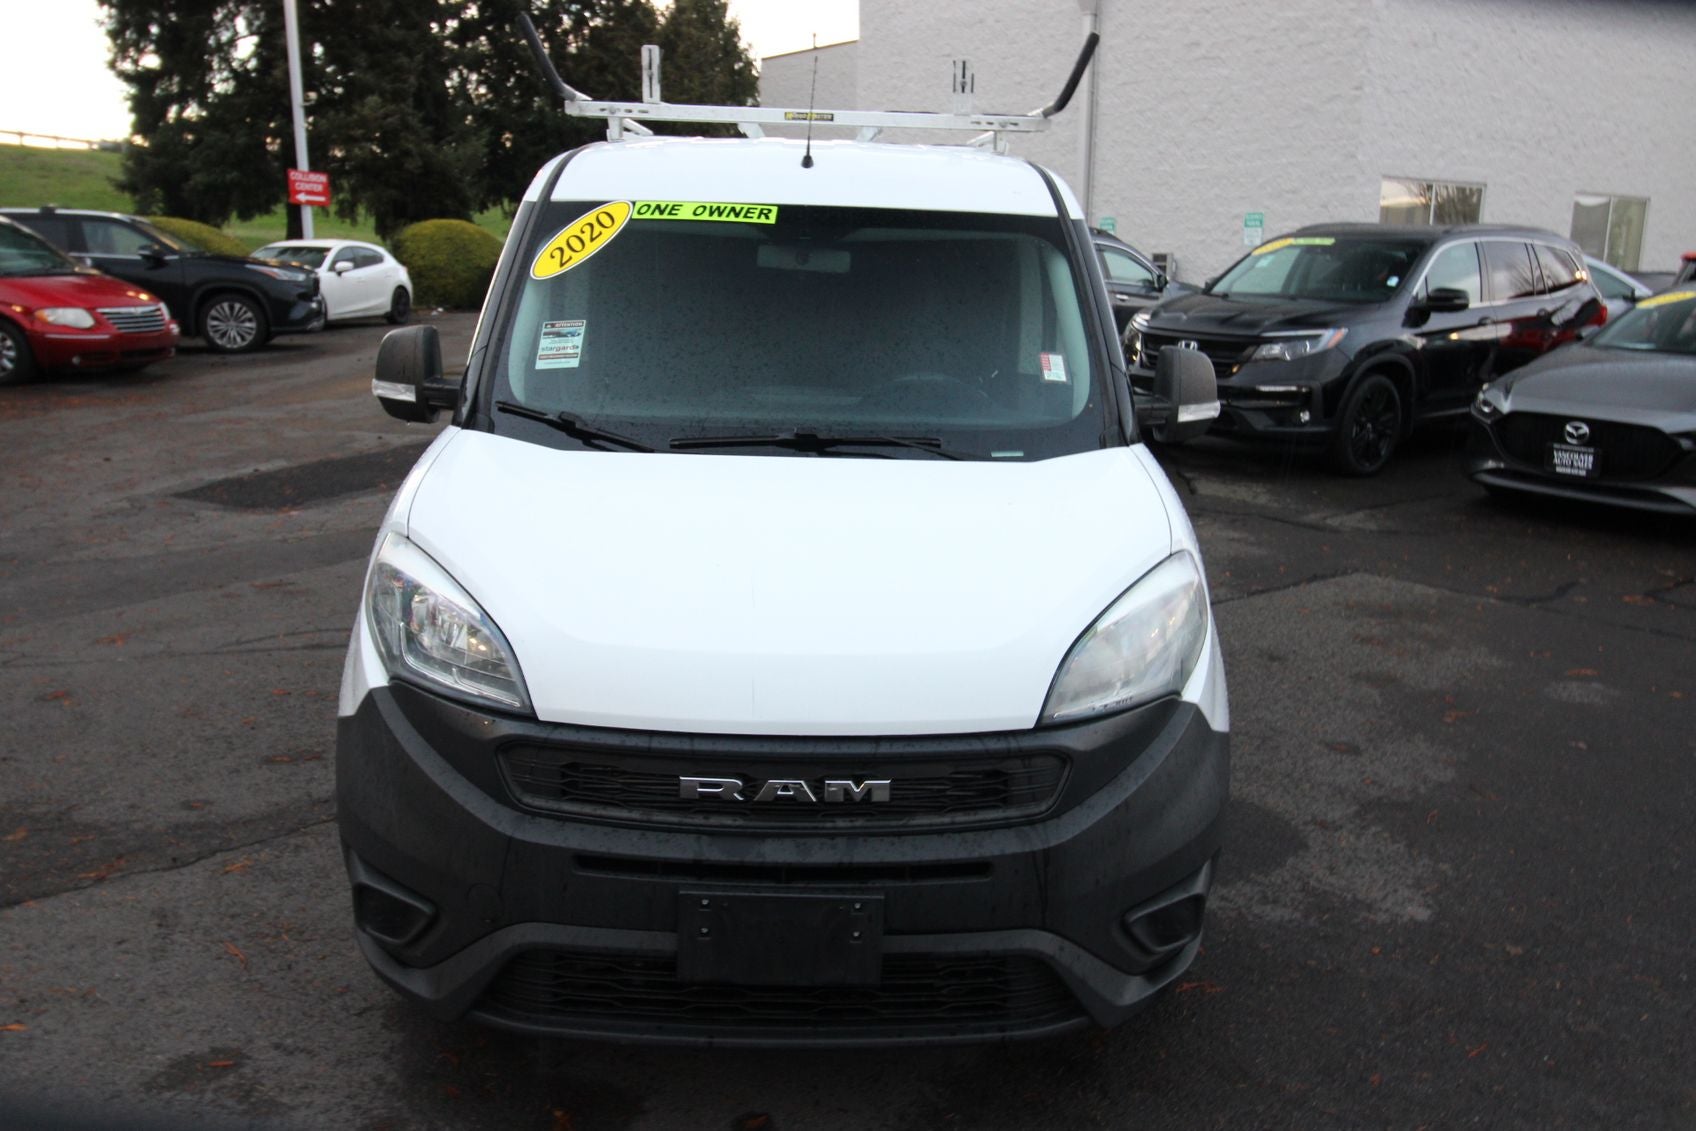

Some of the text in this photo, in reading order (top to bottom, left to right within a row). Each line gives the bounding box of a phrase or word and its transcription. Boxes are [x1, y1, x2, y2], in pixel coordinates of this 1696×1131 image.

[290, 171, 328, 183] COLLISION
[295, 182, 323, 192] CENTER
[636, 203, 773, 221] ONE OWNER
[550, 211, 616, 268] 2020
[679, 776, 891, 802] RAM
